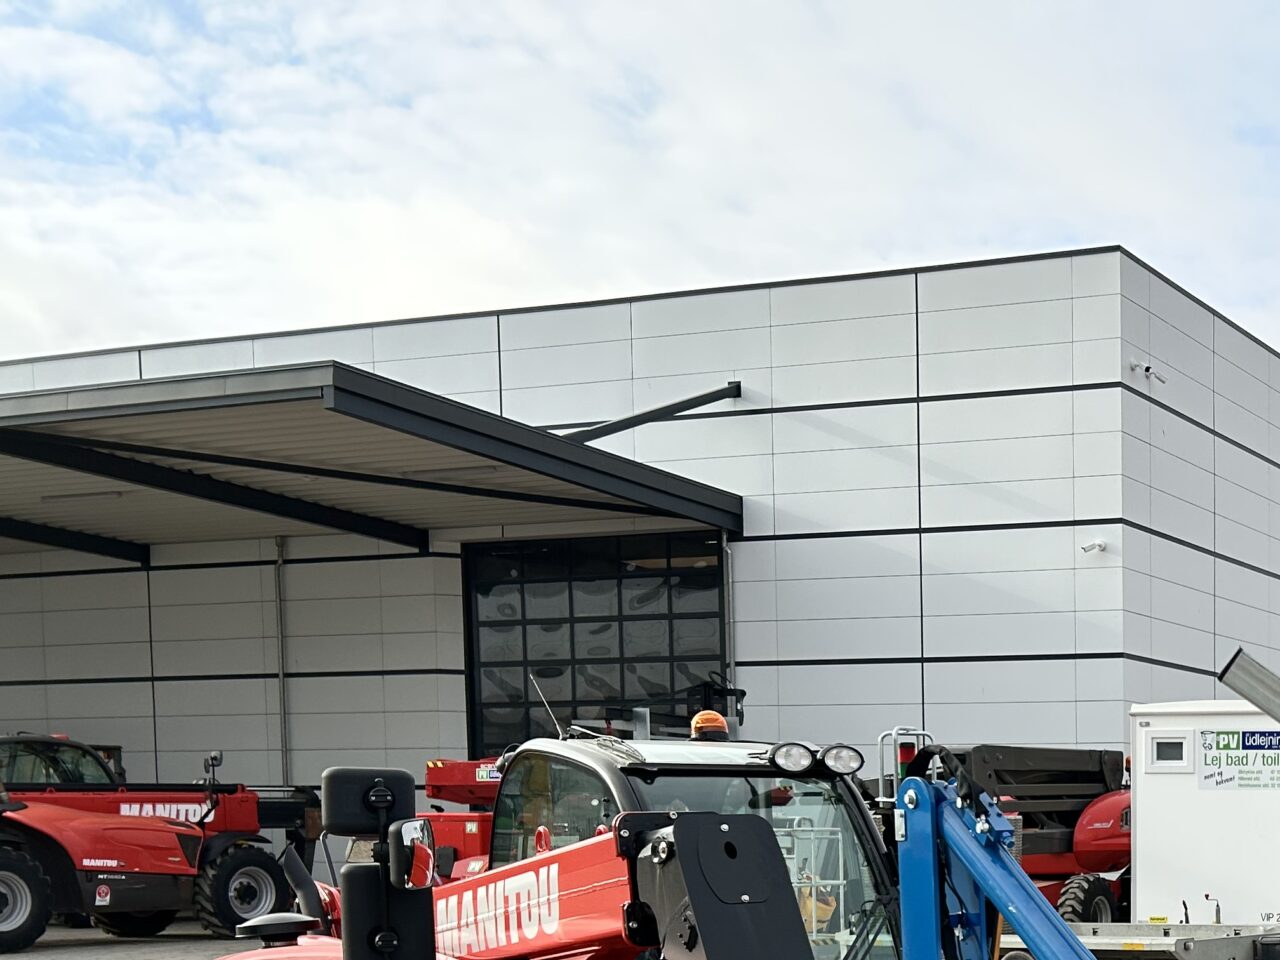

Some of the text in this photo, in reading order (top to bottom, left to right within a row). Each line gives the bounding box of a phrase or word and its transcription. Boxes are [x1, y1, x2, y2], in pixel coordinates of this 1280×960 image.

[1219, 734, 1239, 748] PV
[1204, 753, 1222, 769] Lej
[1226, 753, 1248, 766] bad
[1252, 753, 1258, 766] /
[119, 803, 215, 823] MANITOU
[82, 858, 118, 867] MANITOU
[436, 862, 560, 957] MANITOU
[1260, 912, 1275, 922] VIP
